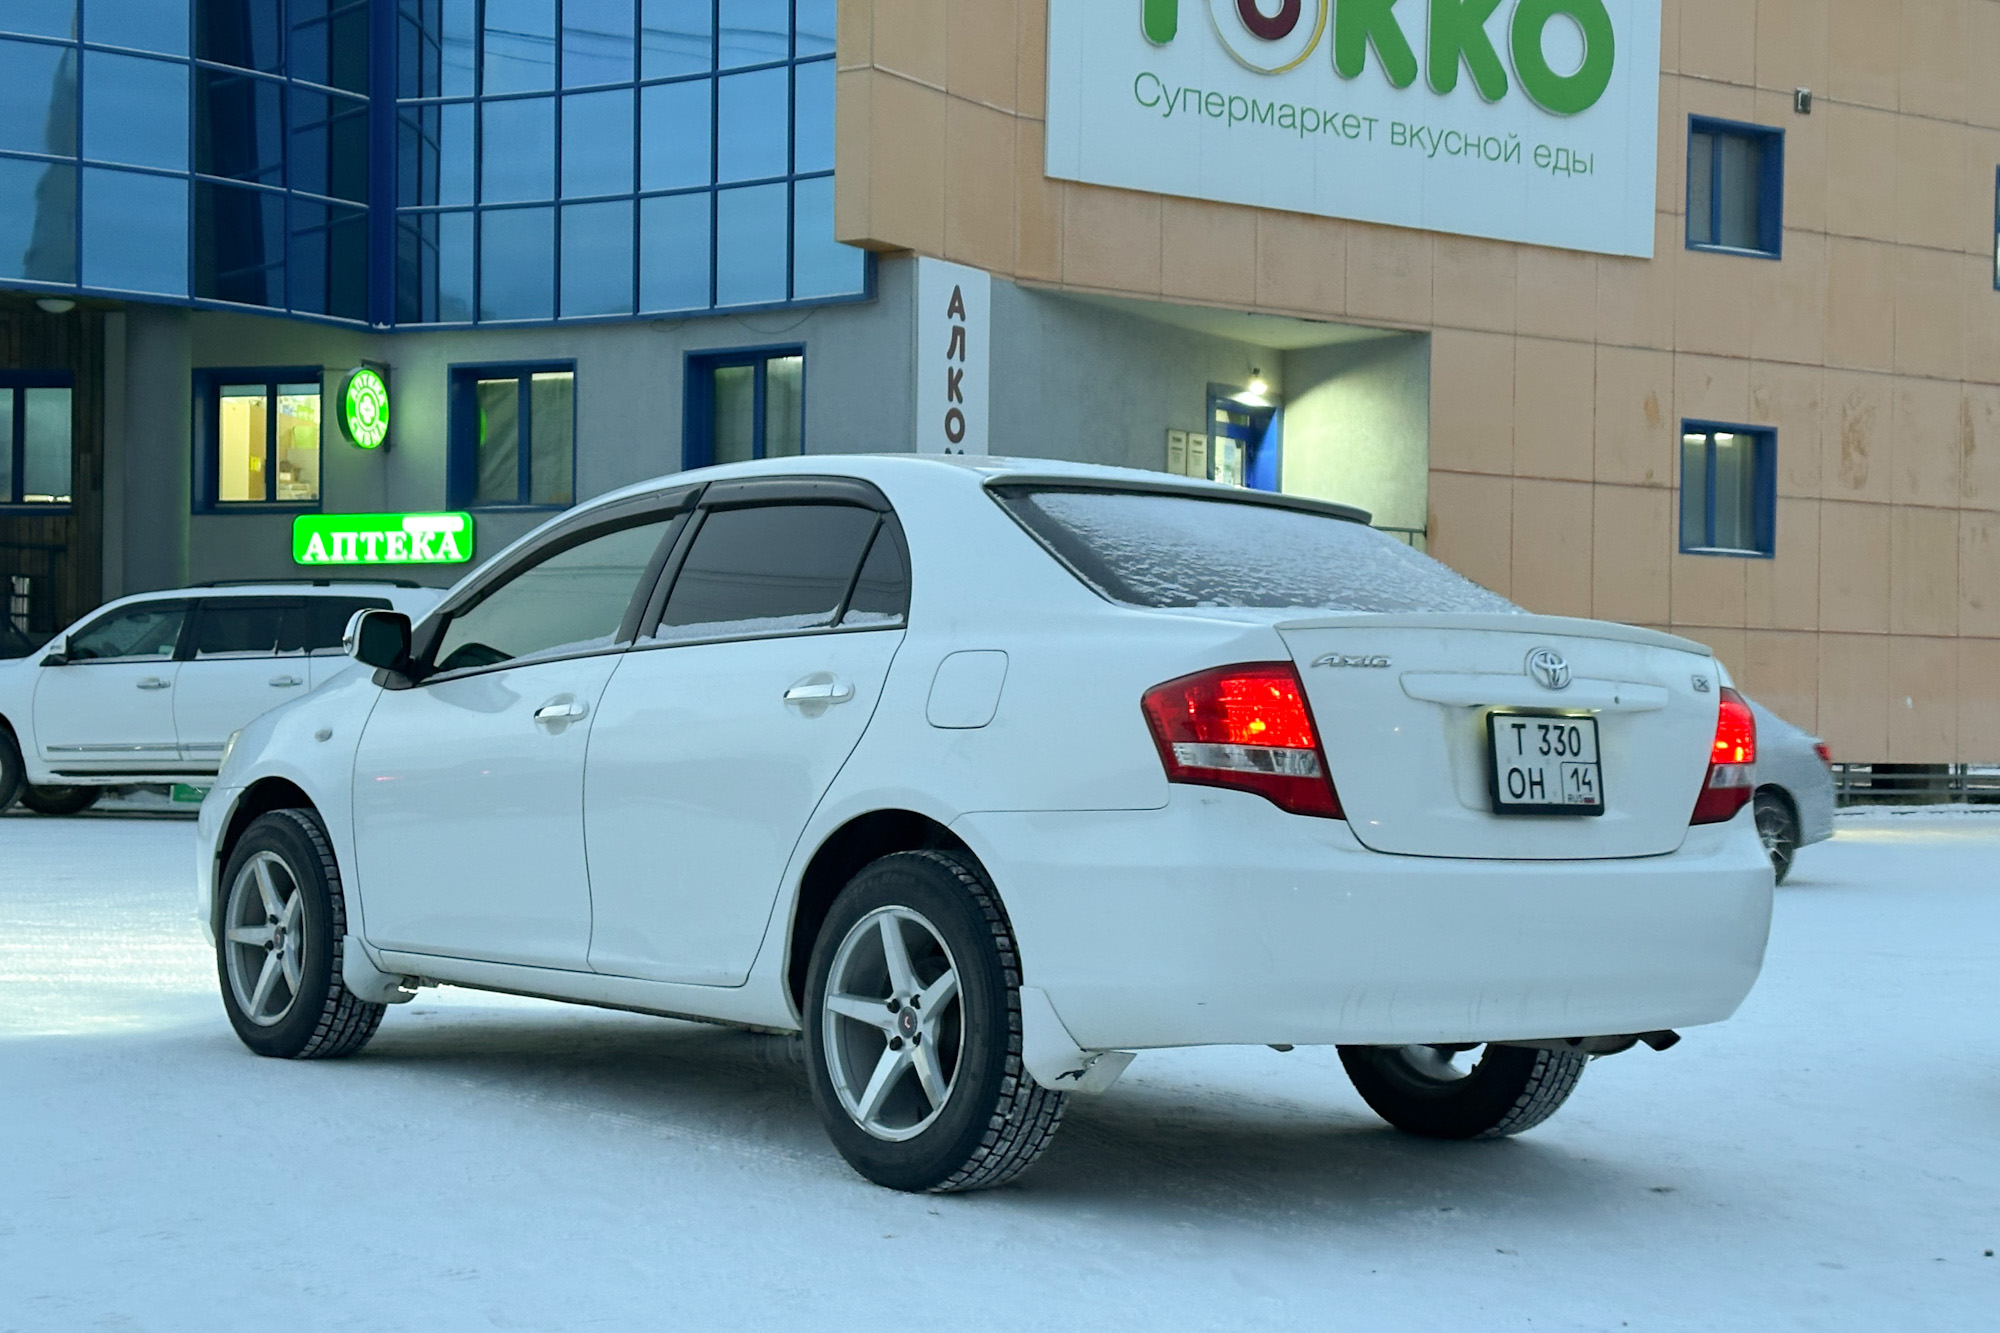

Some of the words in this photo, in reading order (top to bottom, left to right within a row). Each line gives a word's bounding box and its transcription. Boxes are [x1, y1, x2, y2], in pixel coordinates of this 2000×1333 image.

[1134, 72, 1380, 142] Супермаркет
[1391, 119, 1521, 165] вкусной
[1534, 143, 1594, 178] еды
[945, 284, 965, 454] АЛКО
[350, 373, 385, 406] АПТЕКА
[302, 531, 462, 561] АПТЕКА
[1511, 723, 1526, 755] Т
[1537, 724, 1580, 756] 330
[1508, 767, 1545, 799] ОН
[1570, 767, 1592, 792] 14
